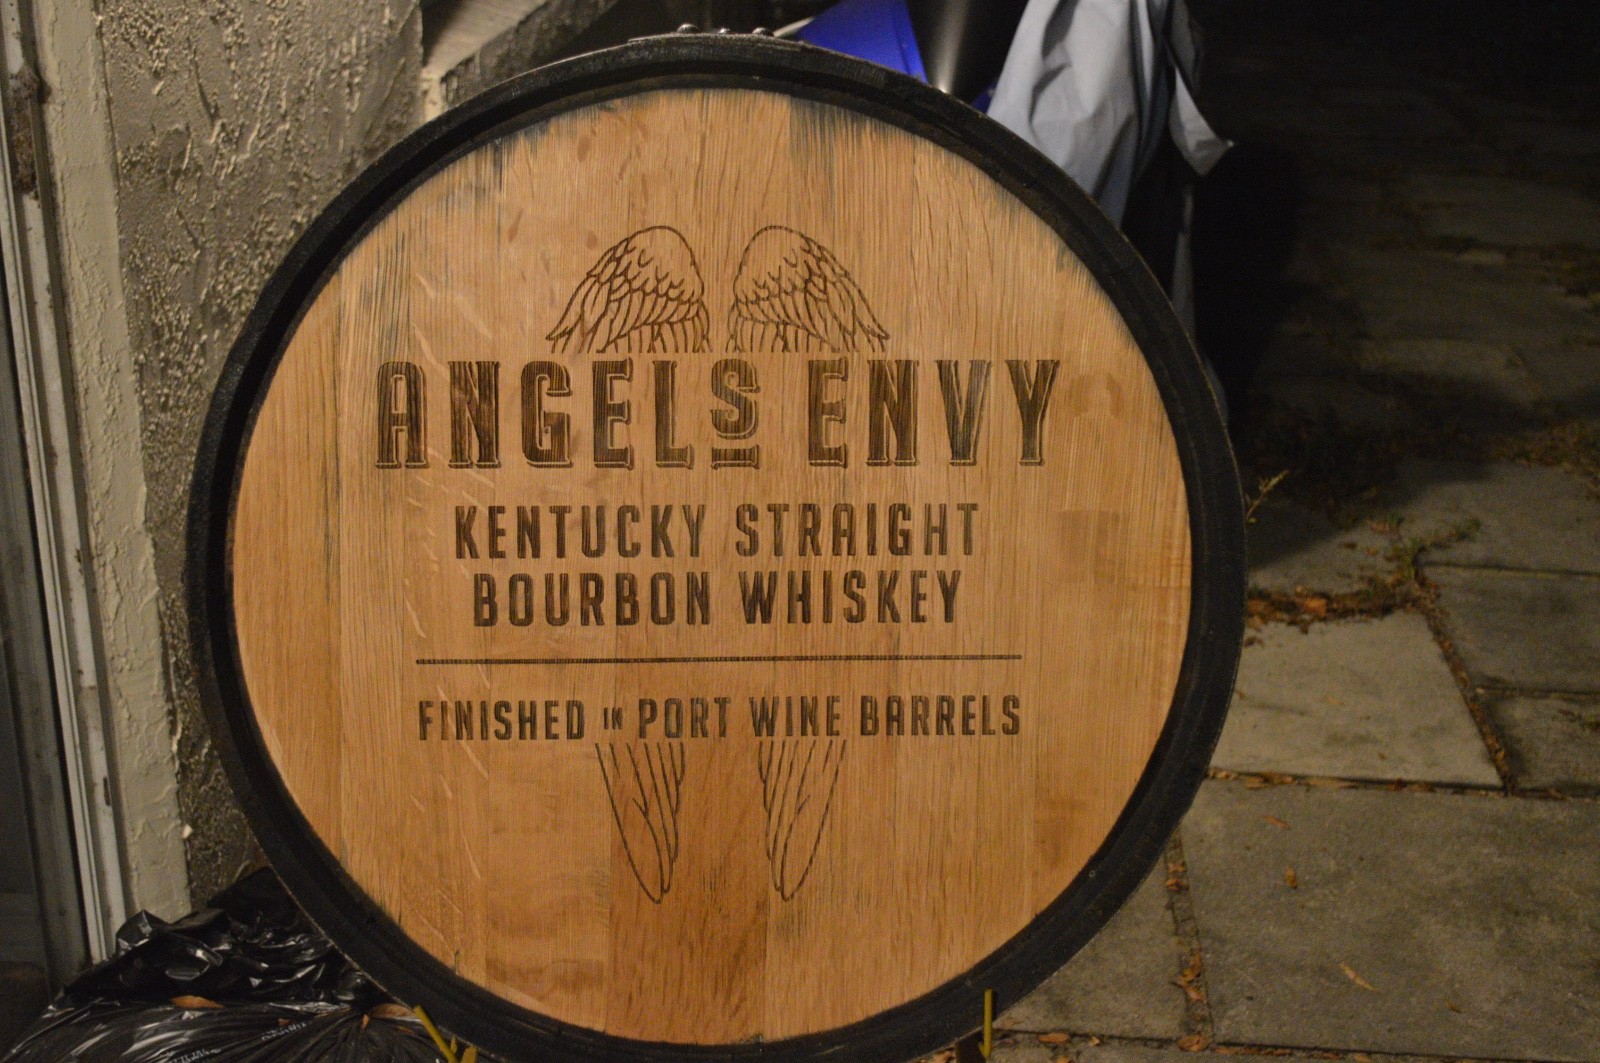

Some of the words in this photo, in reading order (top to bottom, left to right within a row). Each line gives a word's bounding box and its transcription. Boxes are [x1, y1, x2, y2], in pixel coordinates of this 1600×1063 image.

[807, 356, 1061, 468] ENVY
[455, 504, 706, 560] KENTUCKY
[735, 503, 979, 557] STRAIGHT
[473, 572, 711, 628] BOURBON
[738, 570, 962, 625] WHISKEY
[418, 700, 585, 741] FINISHED
[638, 697, 732, 739] PORT
[749, 695, 841, 738] WINE
[860, 694, 1021, 736] BARRELS
